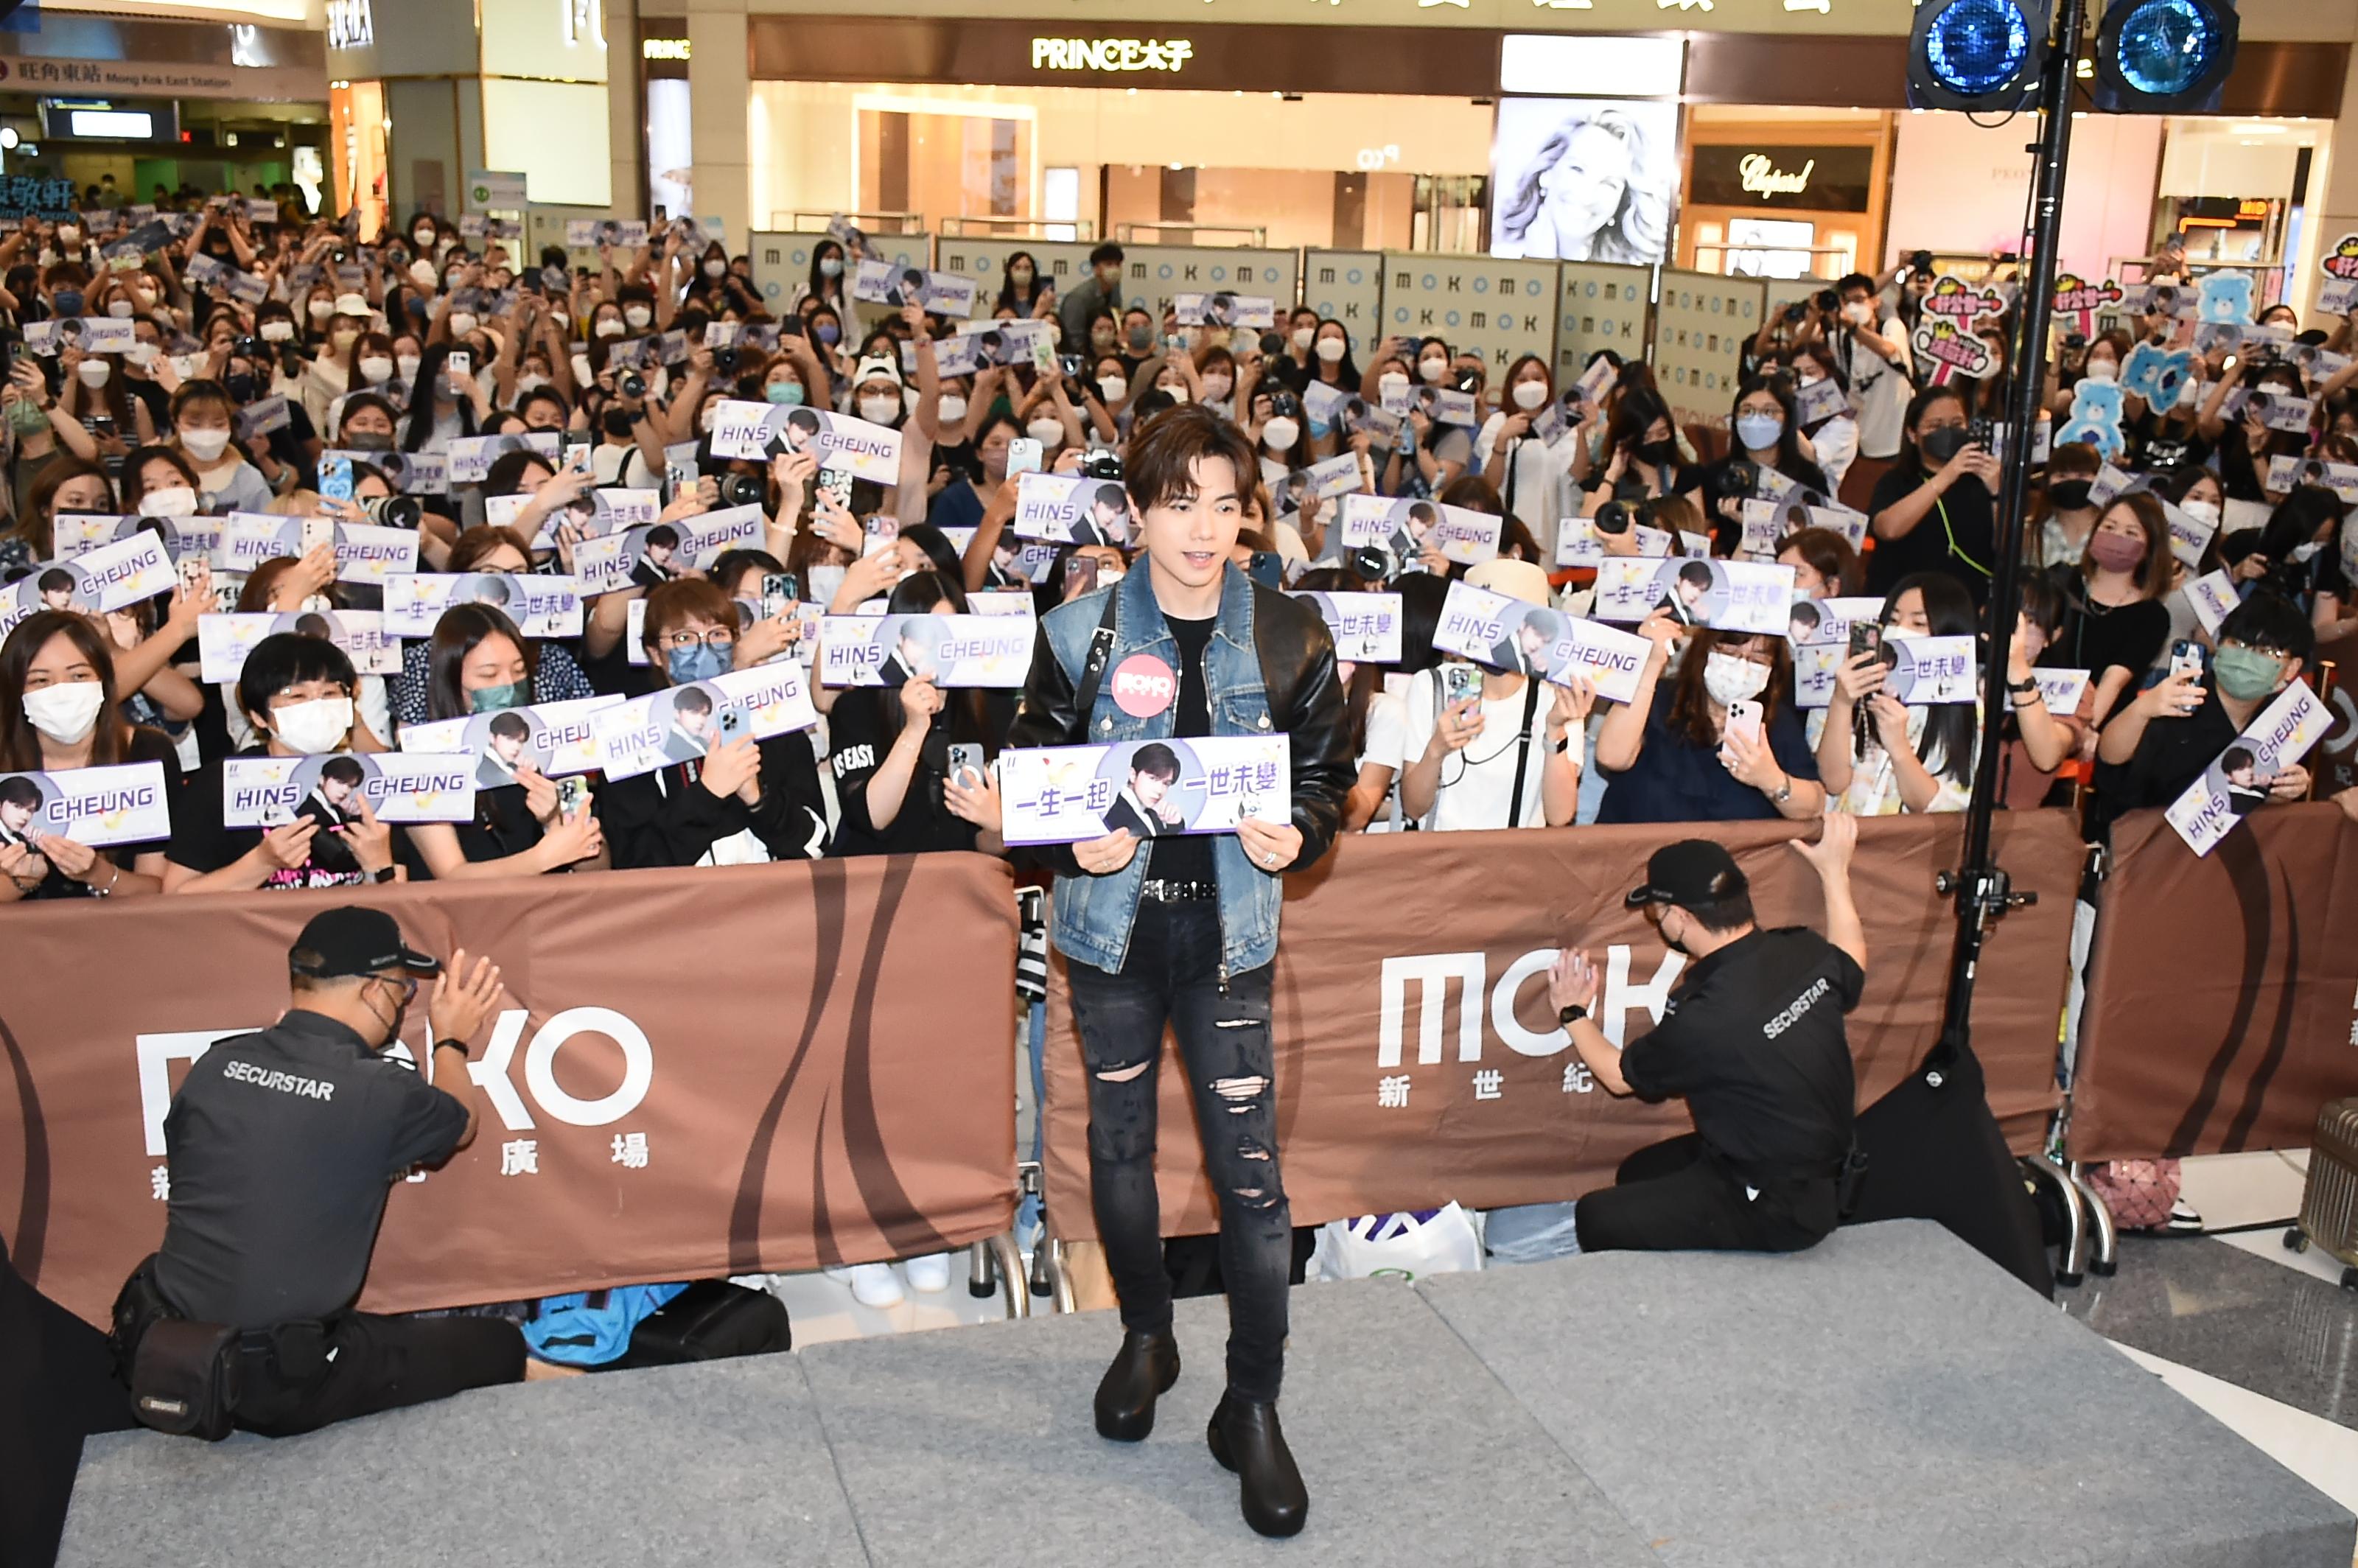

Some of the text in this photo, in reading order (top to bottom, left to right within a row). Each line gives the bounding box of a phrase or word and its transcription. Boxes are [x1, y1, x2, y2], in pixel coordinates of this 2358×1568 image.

[721, 424, 892, 458] HINS CHEUNG
[1026, 503, 1075, 520] HINS
[1351, 518, 1492, 544] HINS CHEUNG
[235, 539, 409, 561] HINS CHEUNG
[584, 522, 755, 578] HINS CHEUNG
[82, 549, 158, 595] CHEUNG
[514, 592, 574, 615] 一世未變
[1605, 580, 1662, 604] 一生一起
[1329, 614, 1392, 636] 一世未變
[830, 637, 1025, 665] HINS CHEUNG
[1448, 615, 1637, 672] HINS CHEUNG
[1902, 657, 1967, 679] 一世未變
[608, 726, 662, 758] HINS
[843, 744, 875, 771] EASY
[2189, 697, 2311, 839] HINS CHEUNG
[48, 788, 153, 822] CHEUNG
[236, 774, 464, 809] HINS CHEUNG
[1016, 763, 1278, 817] 一生一起 一世未變
[1763, 976, 1830, 1040] SECURSTAR
[223, 1060, 335, 1102] SECURSTAR
